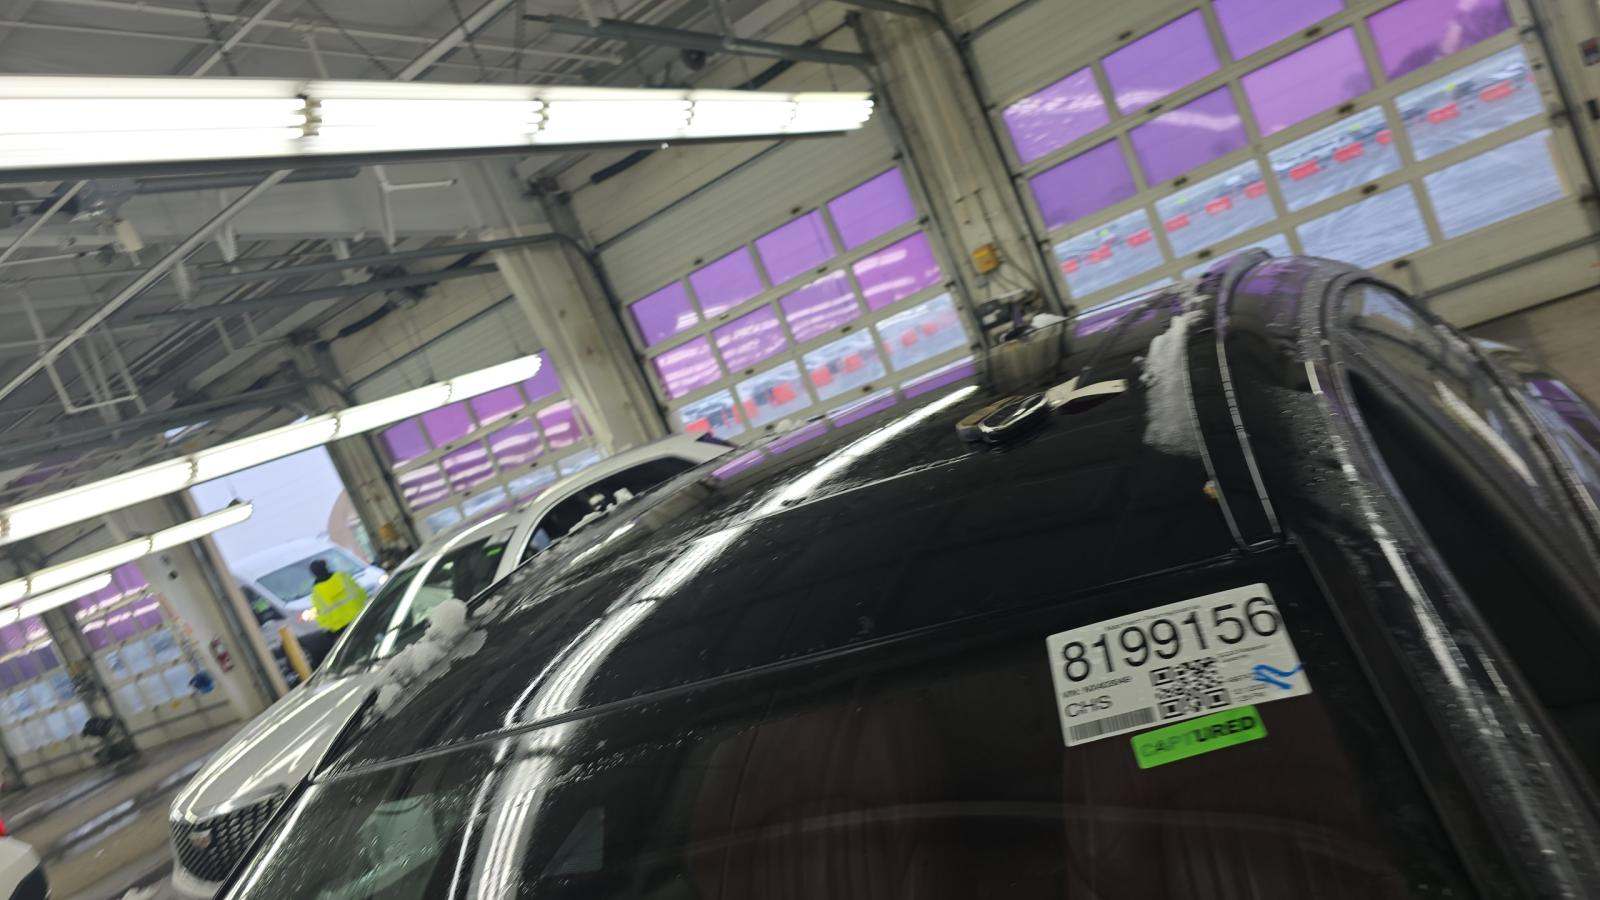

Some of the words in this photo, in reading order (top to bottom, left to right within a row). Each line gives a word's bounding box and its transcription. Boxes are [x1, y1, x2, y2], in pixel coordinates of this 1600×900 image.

[1063, 597, 1279, 682] 8199156
[1065, 695, 1113, 717] CHS
[1142, 716, 1256, 757] CAPTURED
